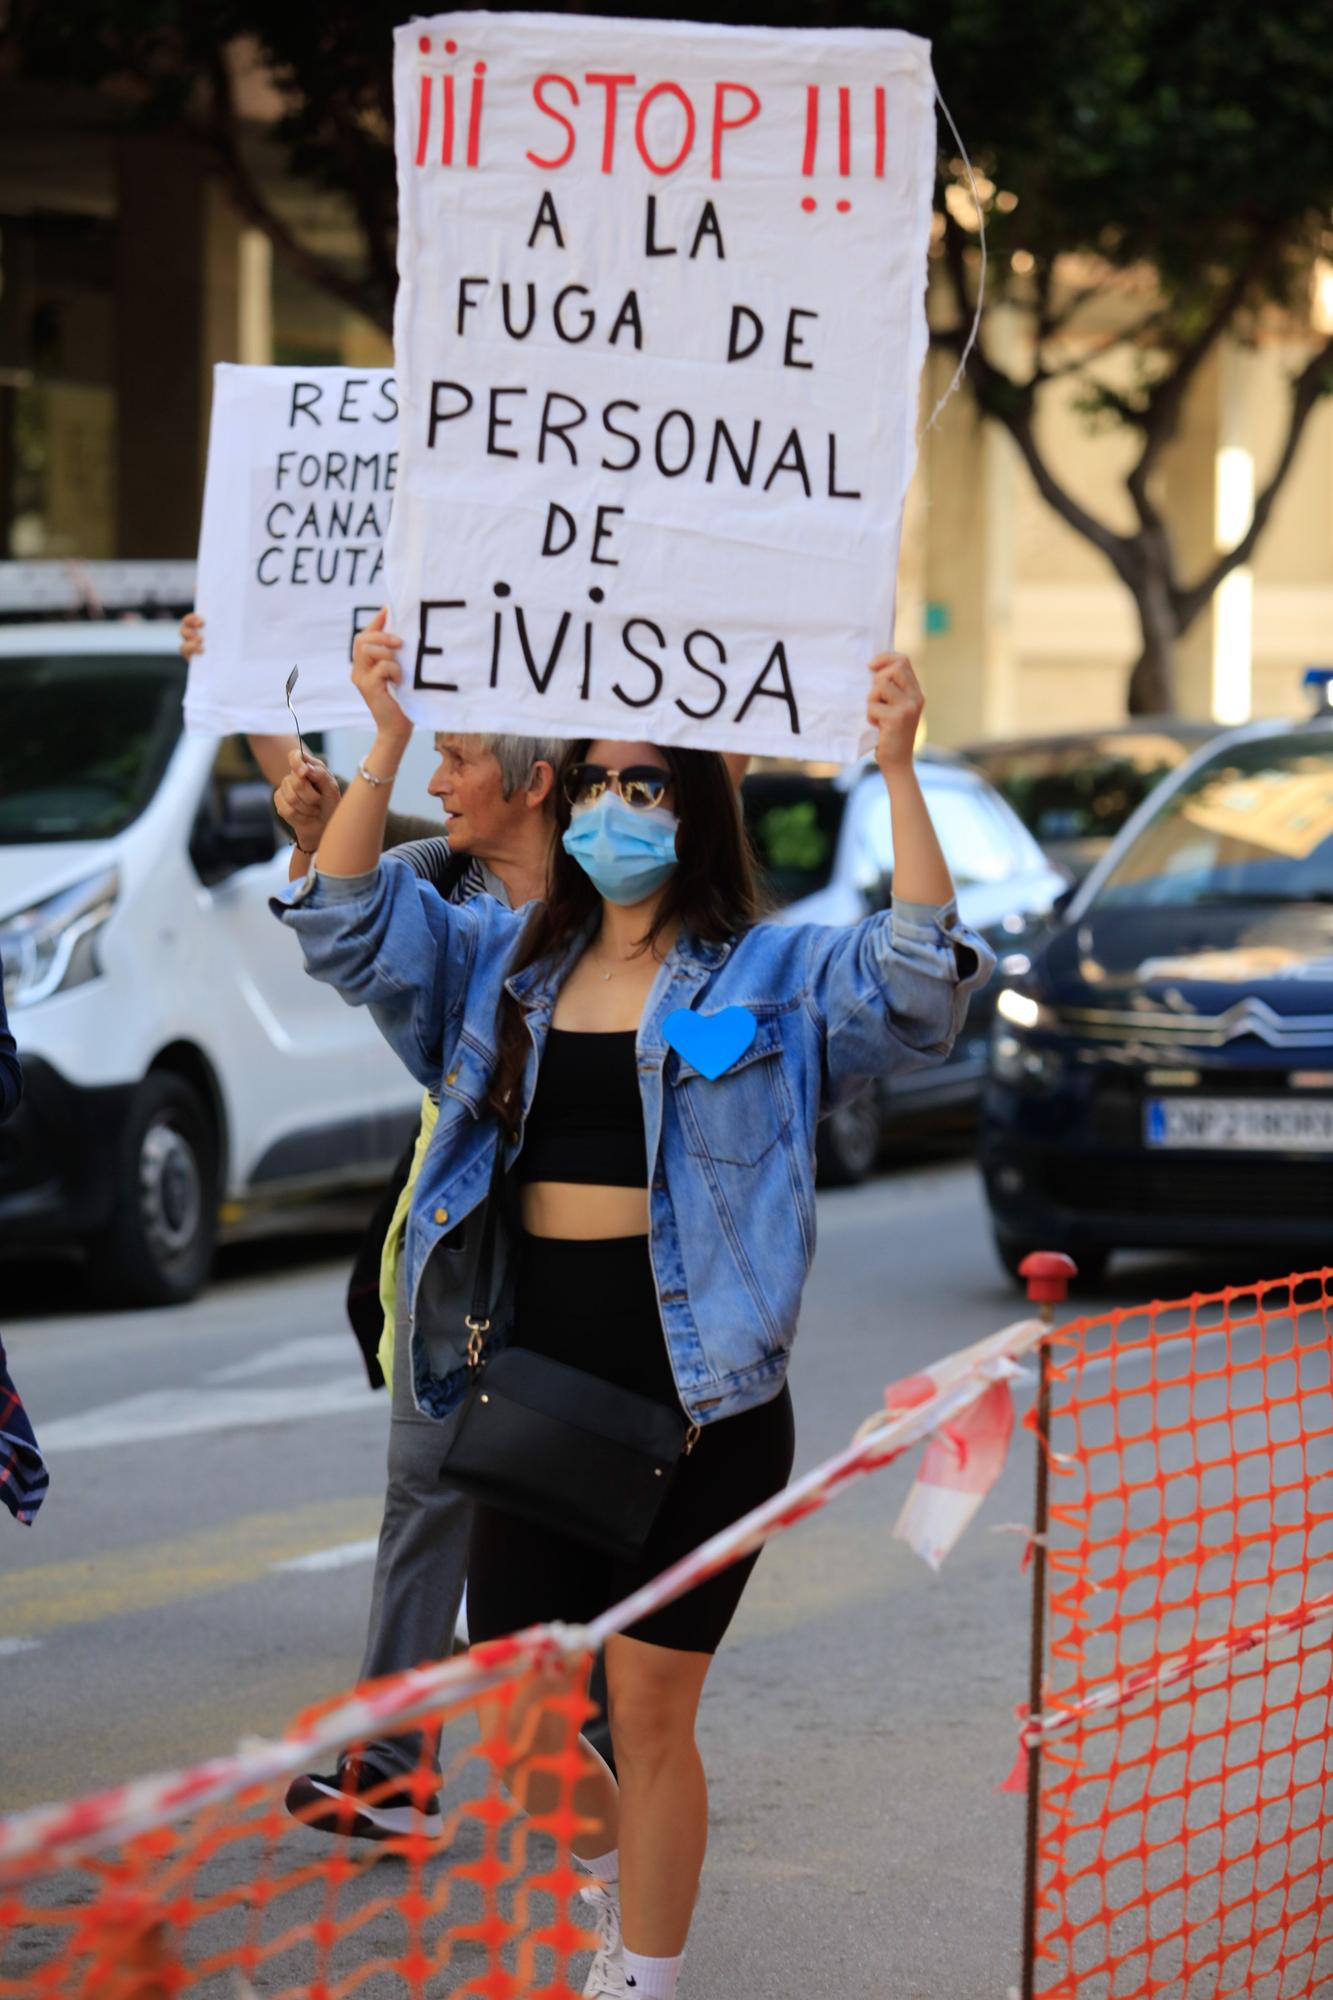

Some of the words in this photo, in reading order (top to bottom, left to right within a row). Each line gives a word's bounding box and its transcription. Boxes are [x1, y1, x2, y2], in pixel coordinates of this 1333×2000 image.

[526, 72, 762, 181] STOP
[527, 190, 566, 249] A
[644, 193, 726, 260] LA
[457, 276, 643, 351] FUGA
[726, 304, 819, 371] DE
[289, 377, 399, 428] RES
[426, 380, 862, 500] PERSONAL
[266, 497, 393, 540] CANA
[540, 501, 625, 567] DE
